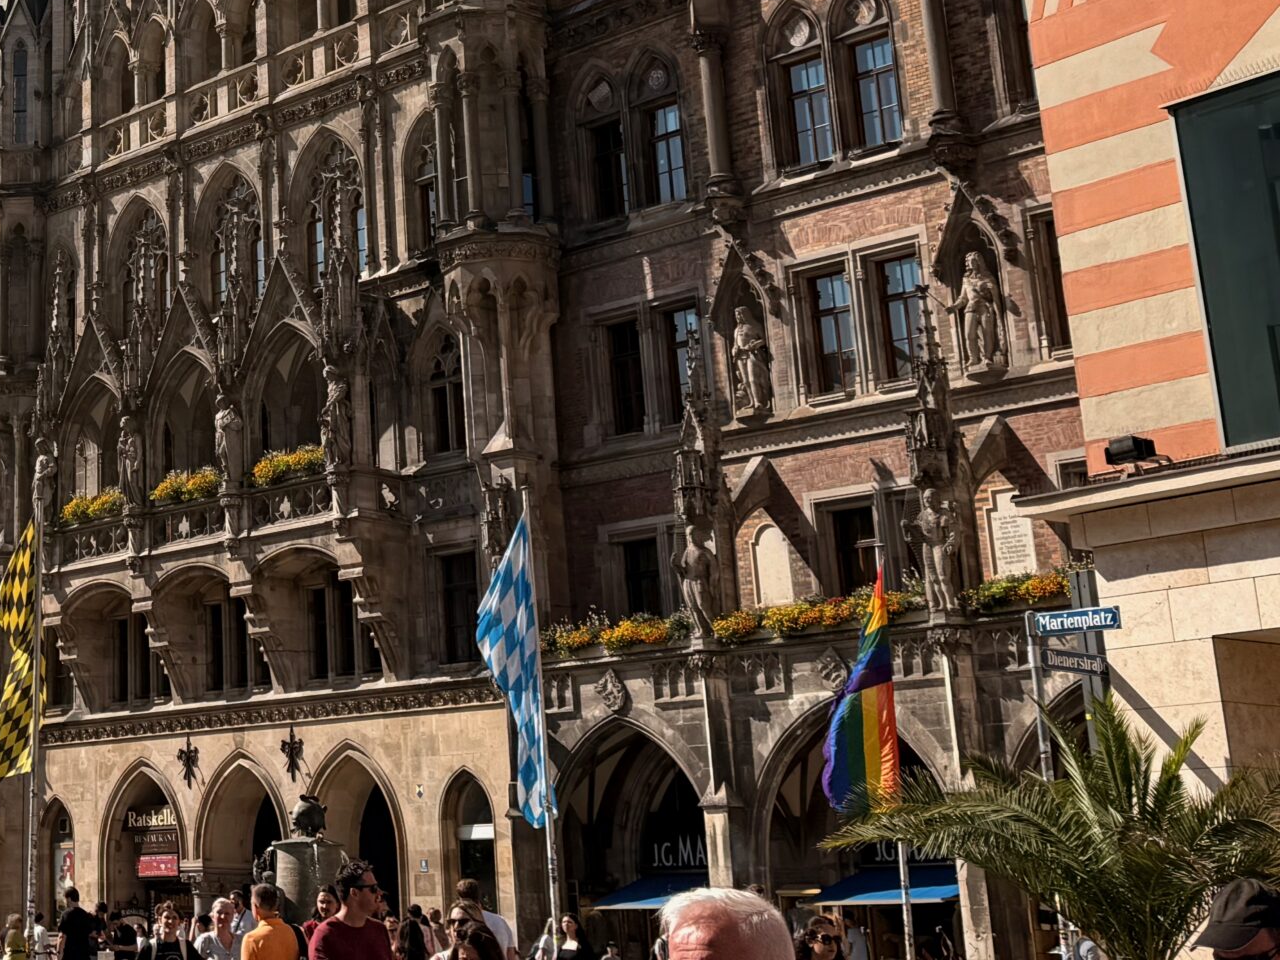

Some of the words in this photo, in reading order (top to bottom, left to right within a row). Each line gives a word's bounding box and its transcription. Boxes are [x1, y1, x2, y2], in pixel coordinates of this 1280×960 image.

[1040, 611, 1114, 631] Marienplatz
[127, 808, 177, 828] Ratskelle
[652, 842, 677, 867] J.G.
[678, 833, 707, 867] MA
